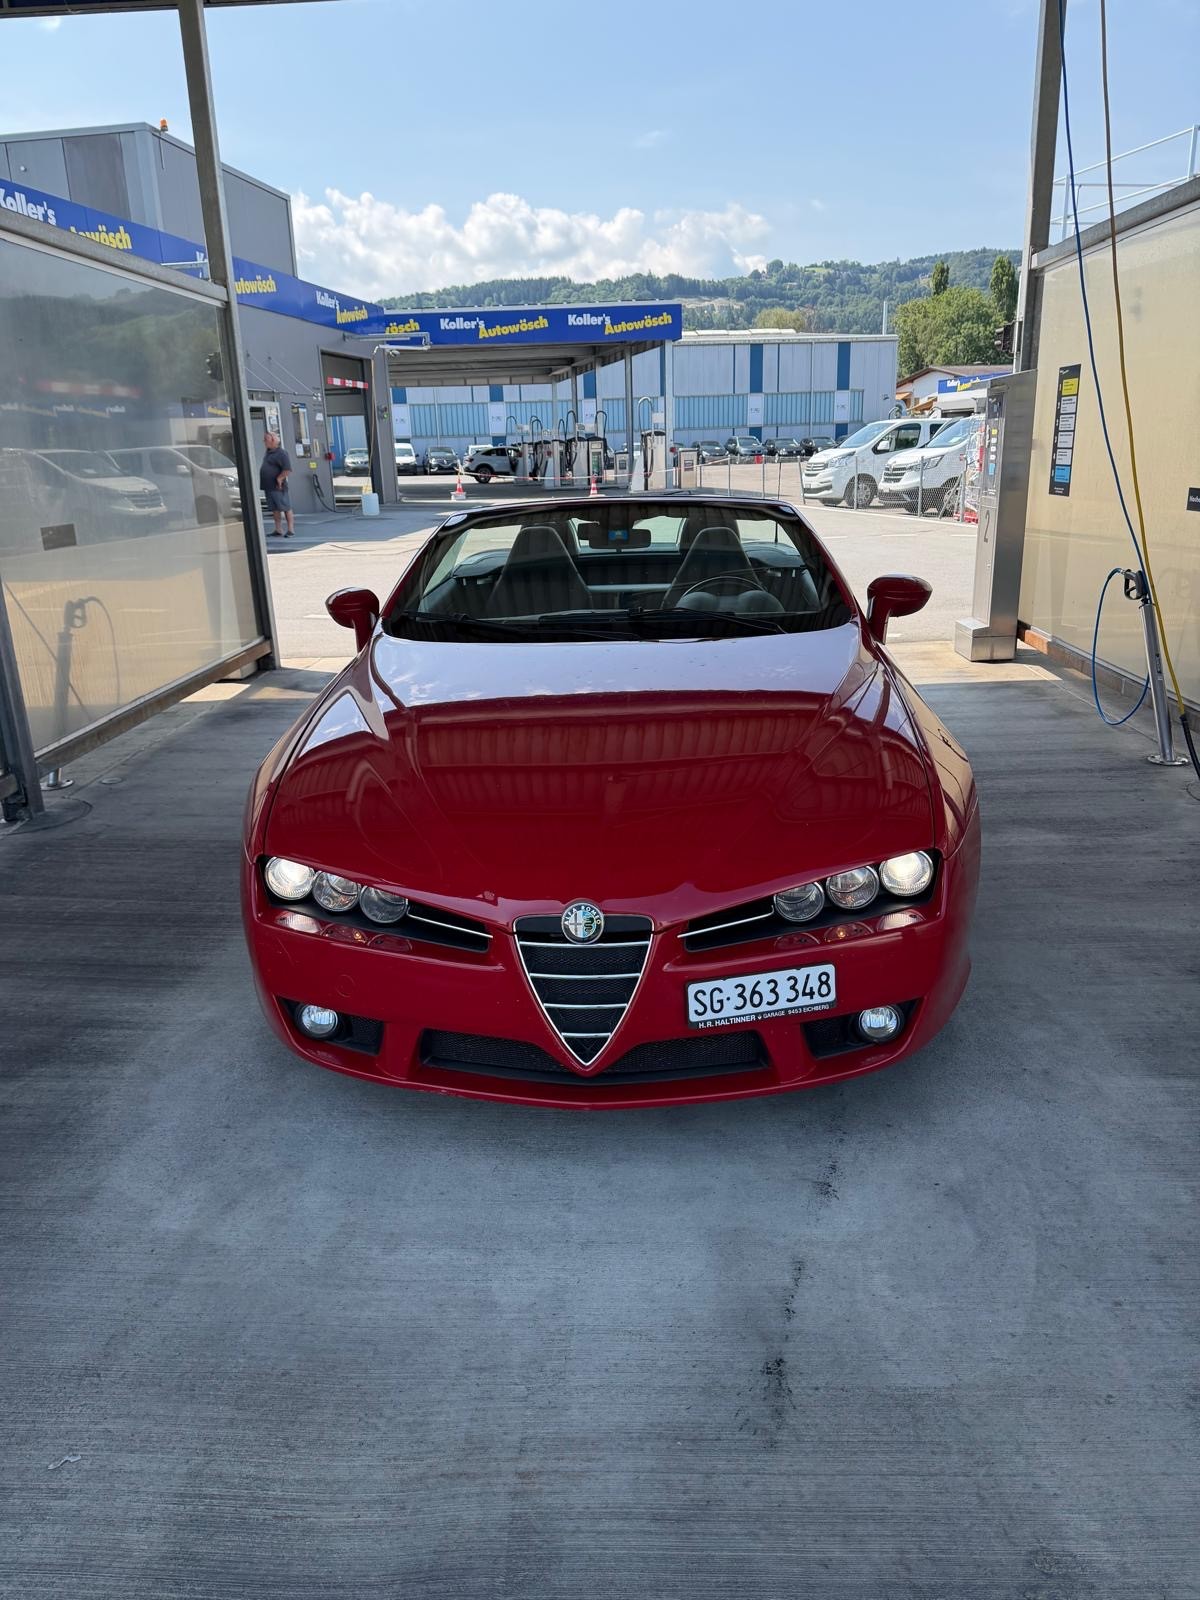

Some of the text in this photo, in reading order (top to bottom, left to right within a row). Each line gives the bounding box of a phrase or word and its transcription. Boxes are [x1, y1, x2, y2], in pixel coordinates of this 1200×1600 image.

[235, 274, 277, 294] utowösch
[439, 317, 485, 330] Koller's
[478, 315, 549, 339] Autowösch
[568, 313, 611, 326] Koller's
[604, 312, 672, 335] Autowösch
[714, 1014, 756, 1027] HALTINNER
[762, 1010, 786, 1020] GARAGE
[802, 1003, 830, 1014] EICHBERG
